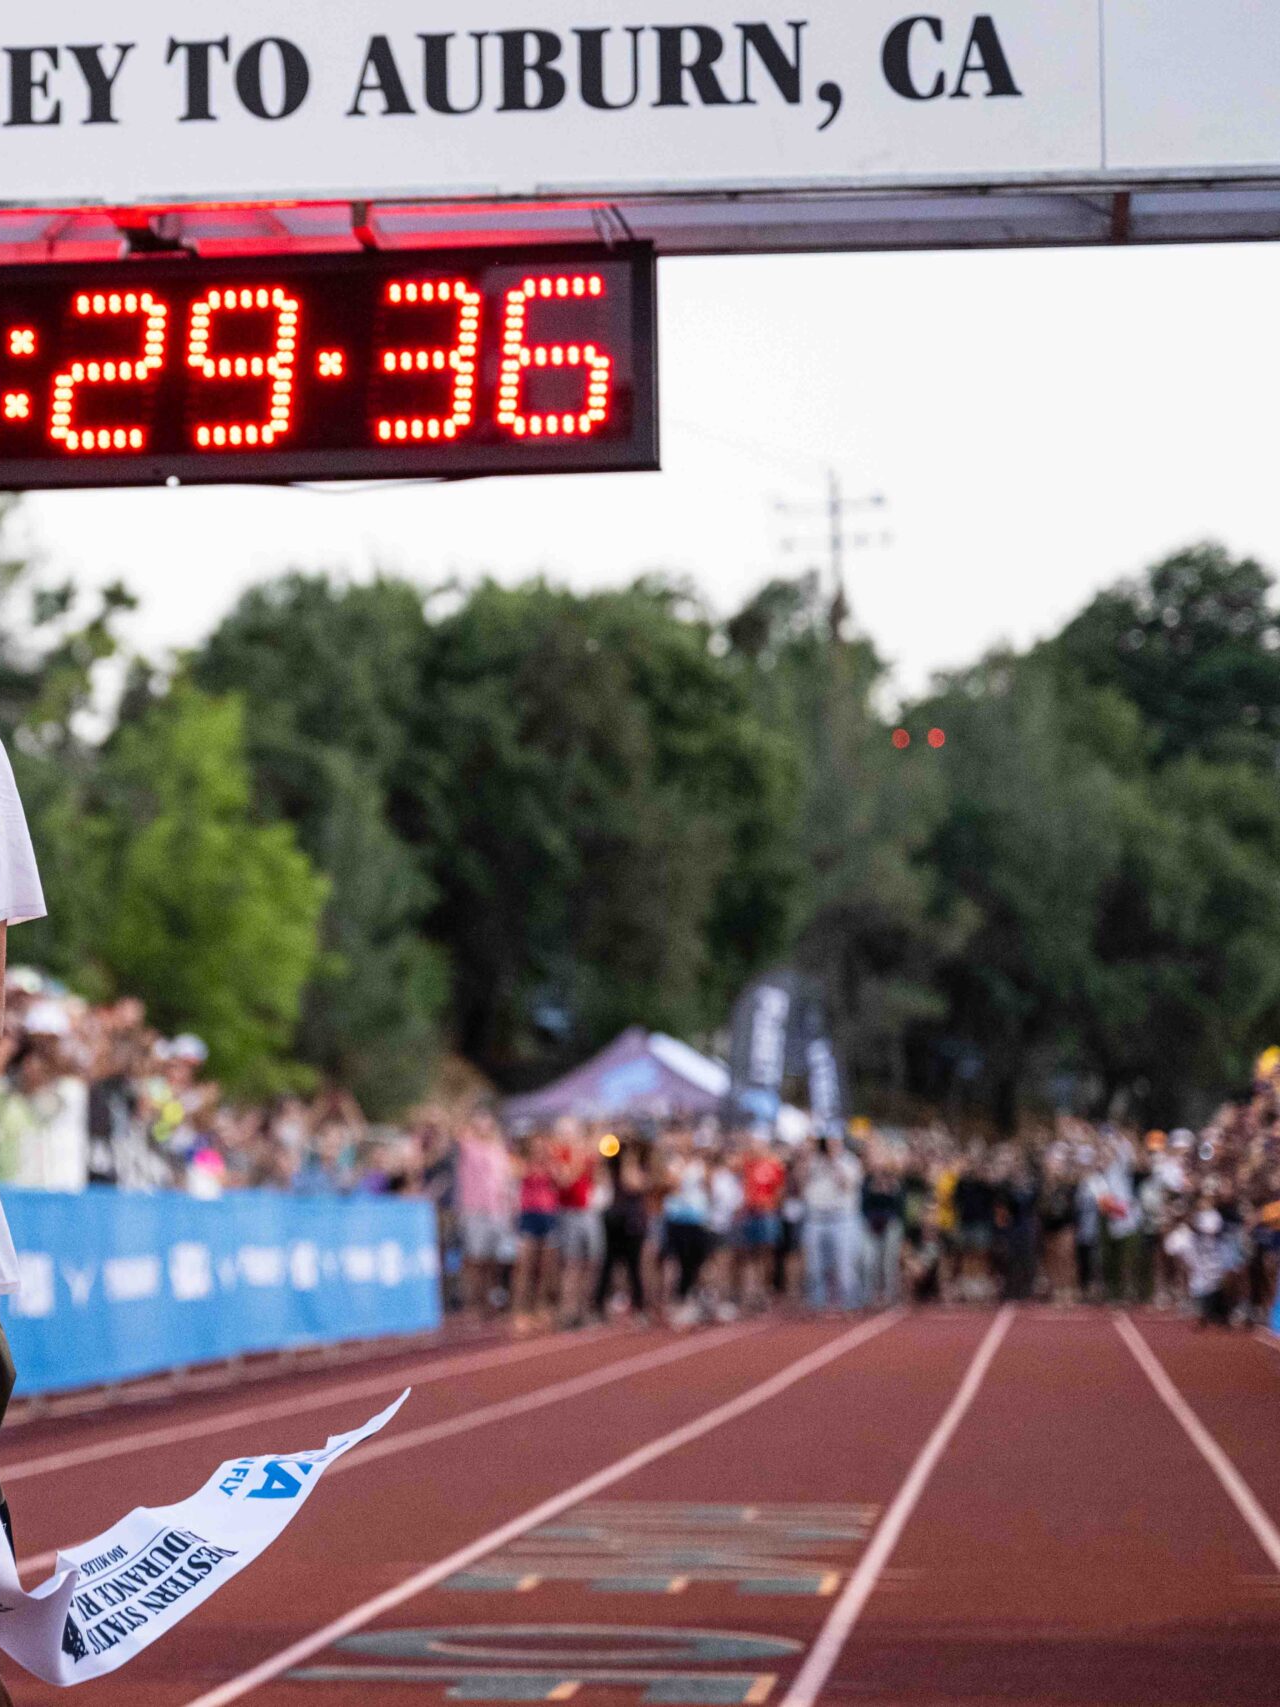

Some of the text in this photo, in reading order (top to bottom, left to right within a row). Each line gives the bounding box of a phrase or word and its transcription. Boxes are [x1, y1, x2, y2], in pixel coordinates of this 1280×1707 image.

[165, 35, 310, 122] TO
[346, 20, 844, 131] AUBURN,
[881, 14, 1024, 101] CA
[218, 1467, 251, 1497] FLY
[80, 1544, 129, 1578] 100 MILES
